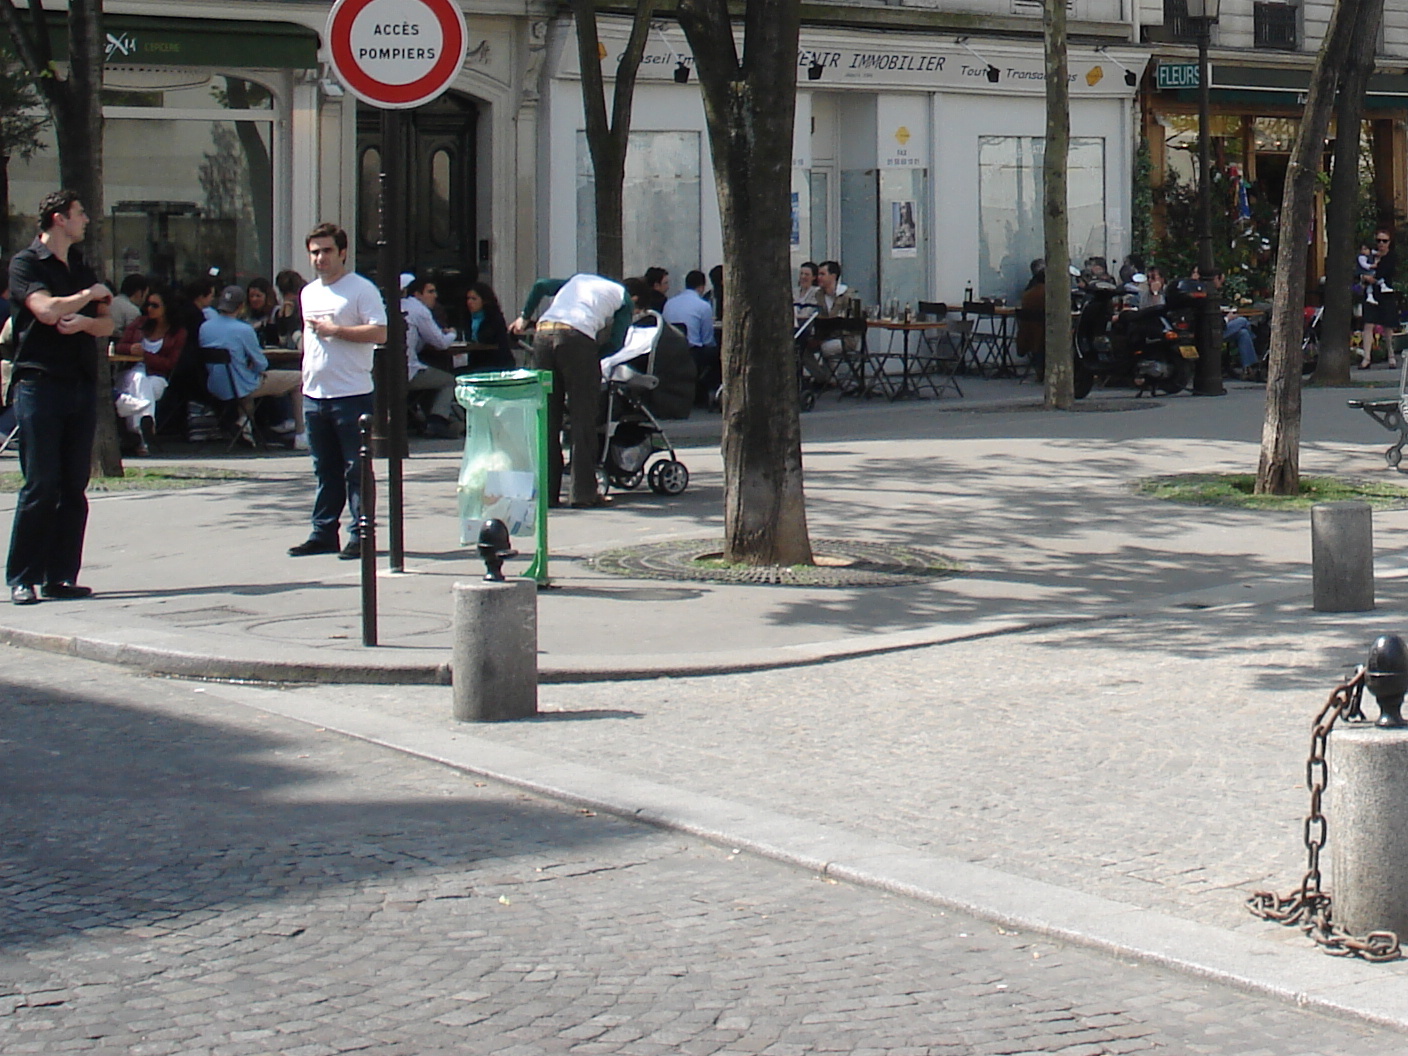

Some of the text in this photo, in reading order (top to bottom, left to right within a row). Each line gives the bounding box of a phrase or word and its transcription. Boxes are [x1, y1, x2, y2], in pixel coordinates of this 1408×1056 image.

[374, 21, 419, 35] ACCÈS
[359, 48, 435, 59] POMPIERS
[849, 53, 946, 71] IMMOBILIER
[961, 65, 988, 76] Tout
[1160, 65, 1200, 84] FLEURS
